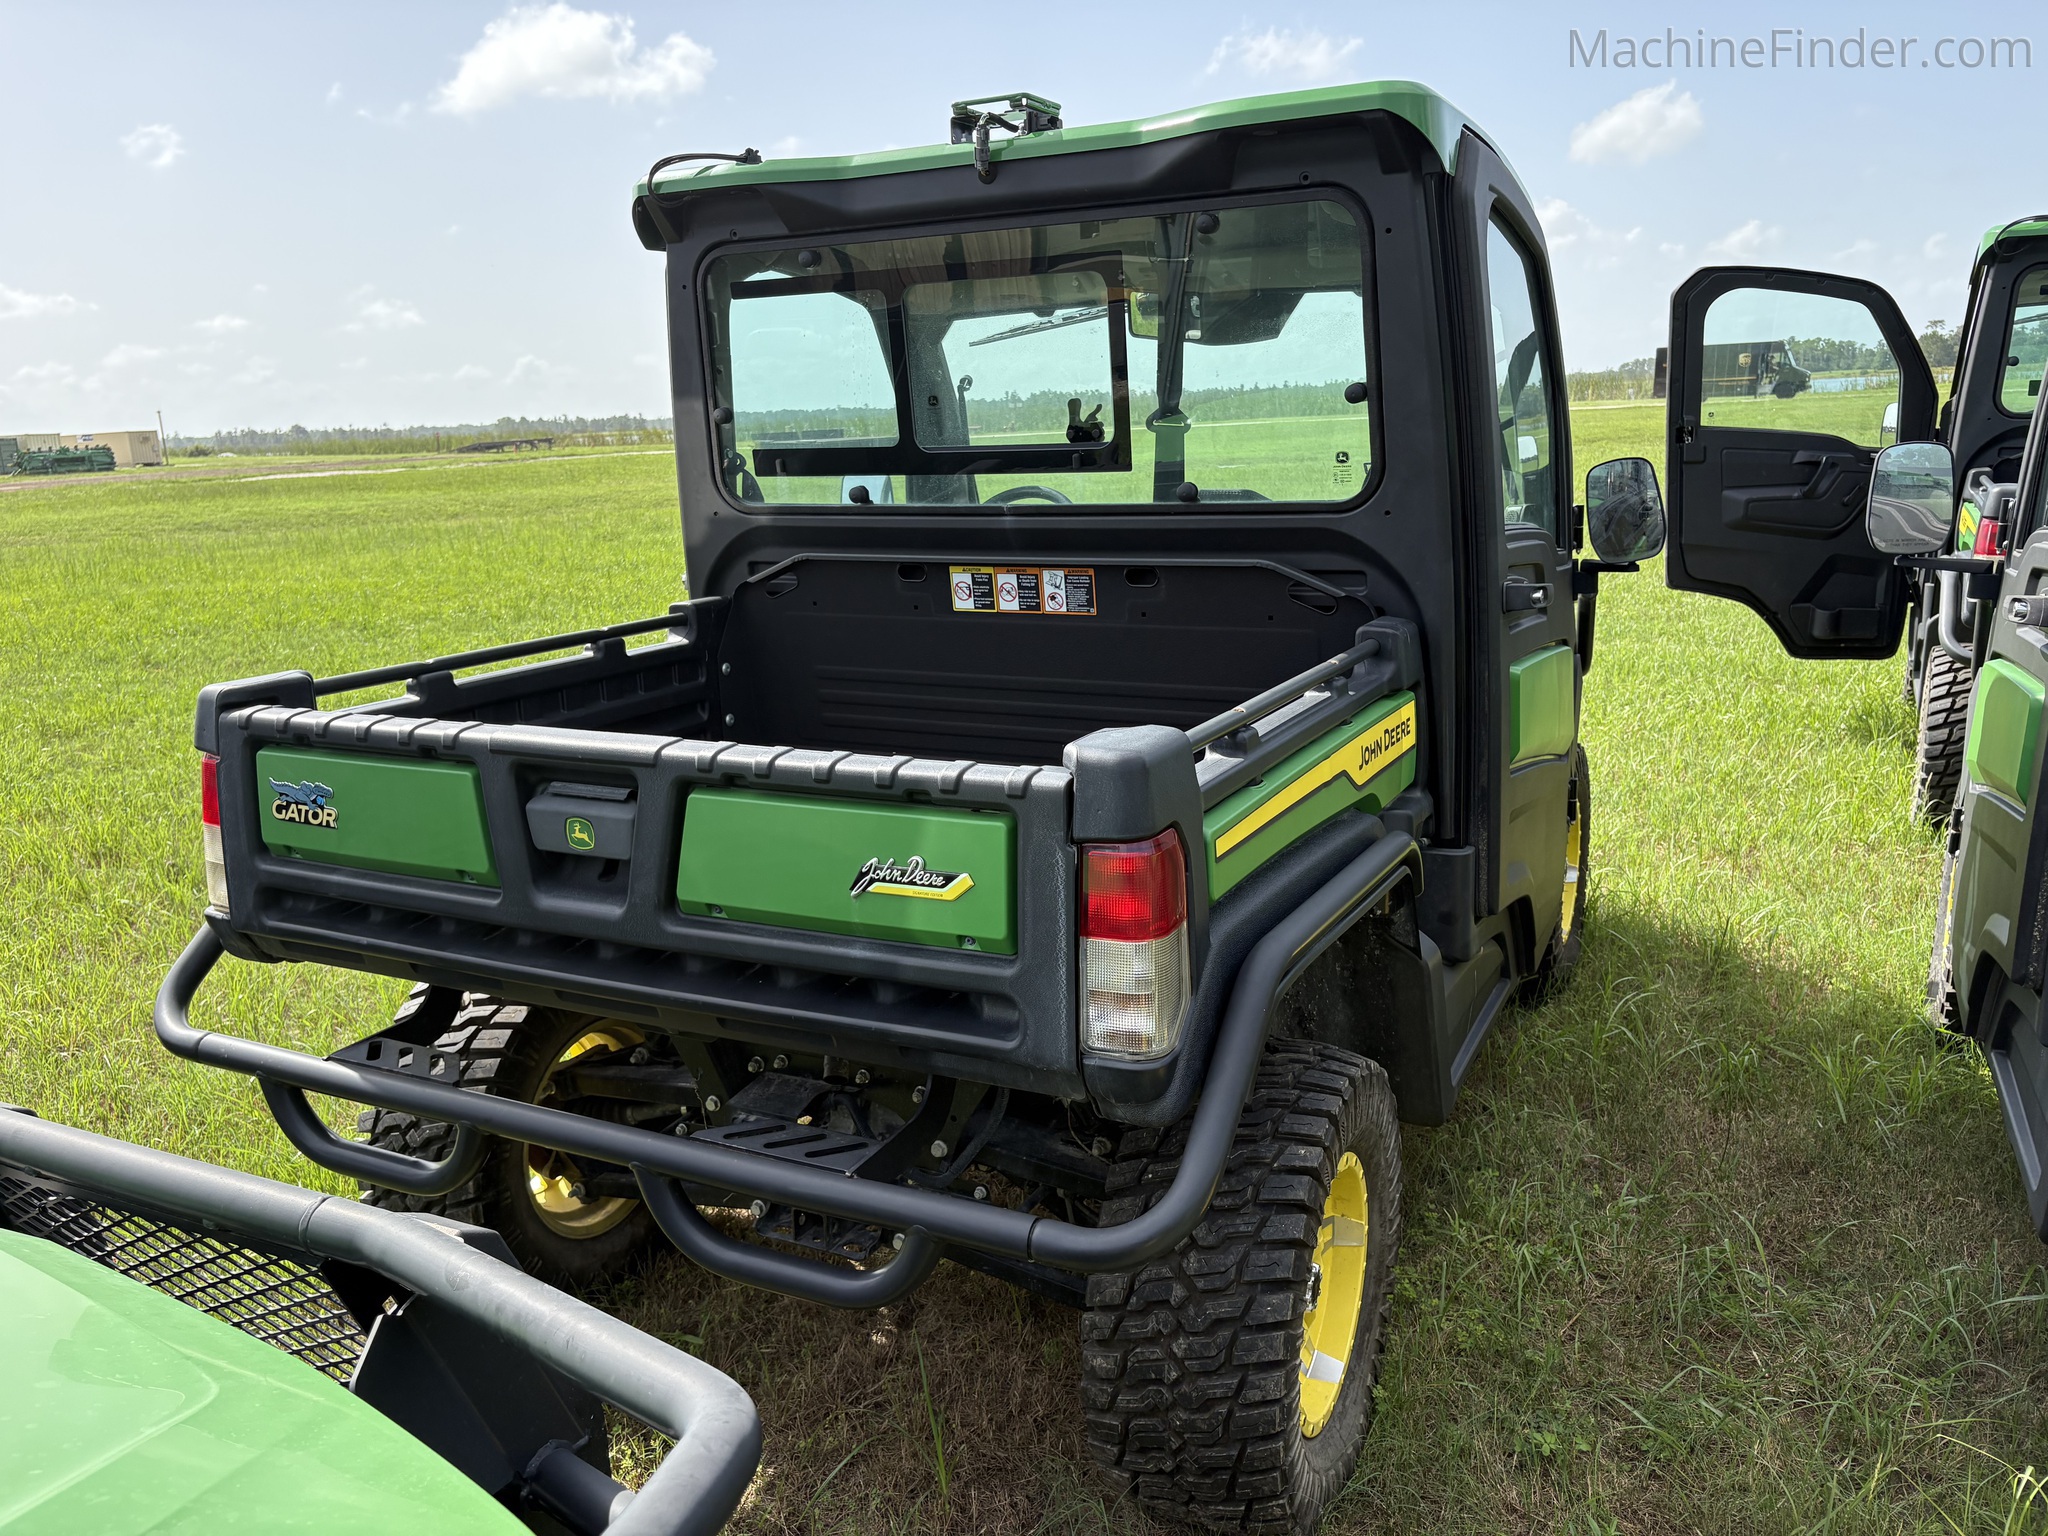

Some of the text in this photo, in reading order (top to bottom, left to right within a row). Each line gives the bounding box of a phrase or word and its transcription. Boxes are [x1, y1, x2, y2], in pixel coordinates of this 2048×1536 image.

[1358, 716, 1411, 771] JOHN DEERE
[272, 799, 335, 828] GATOR
[851, 855, 946, 898] John Deere
